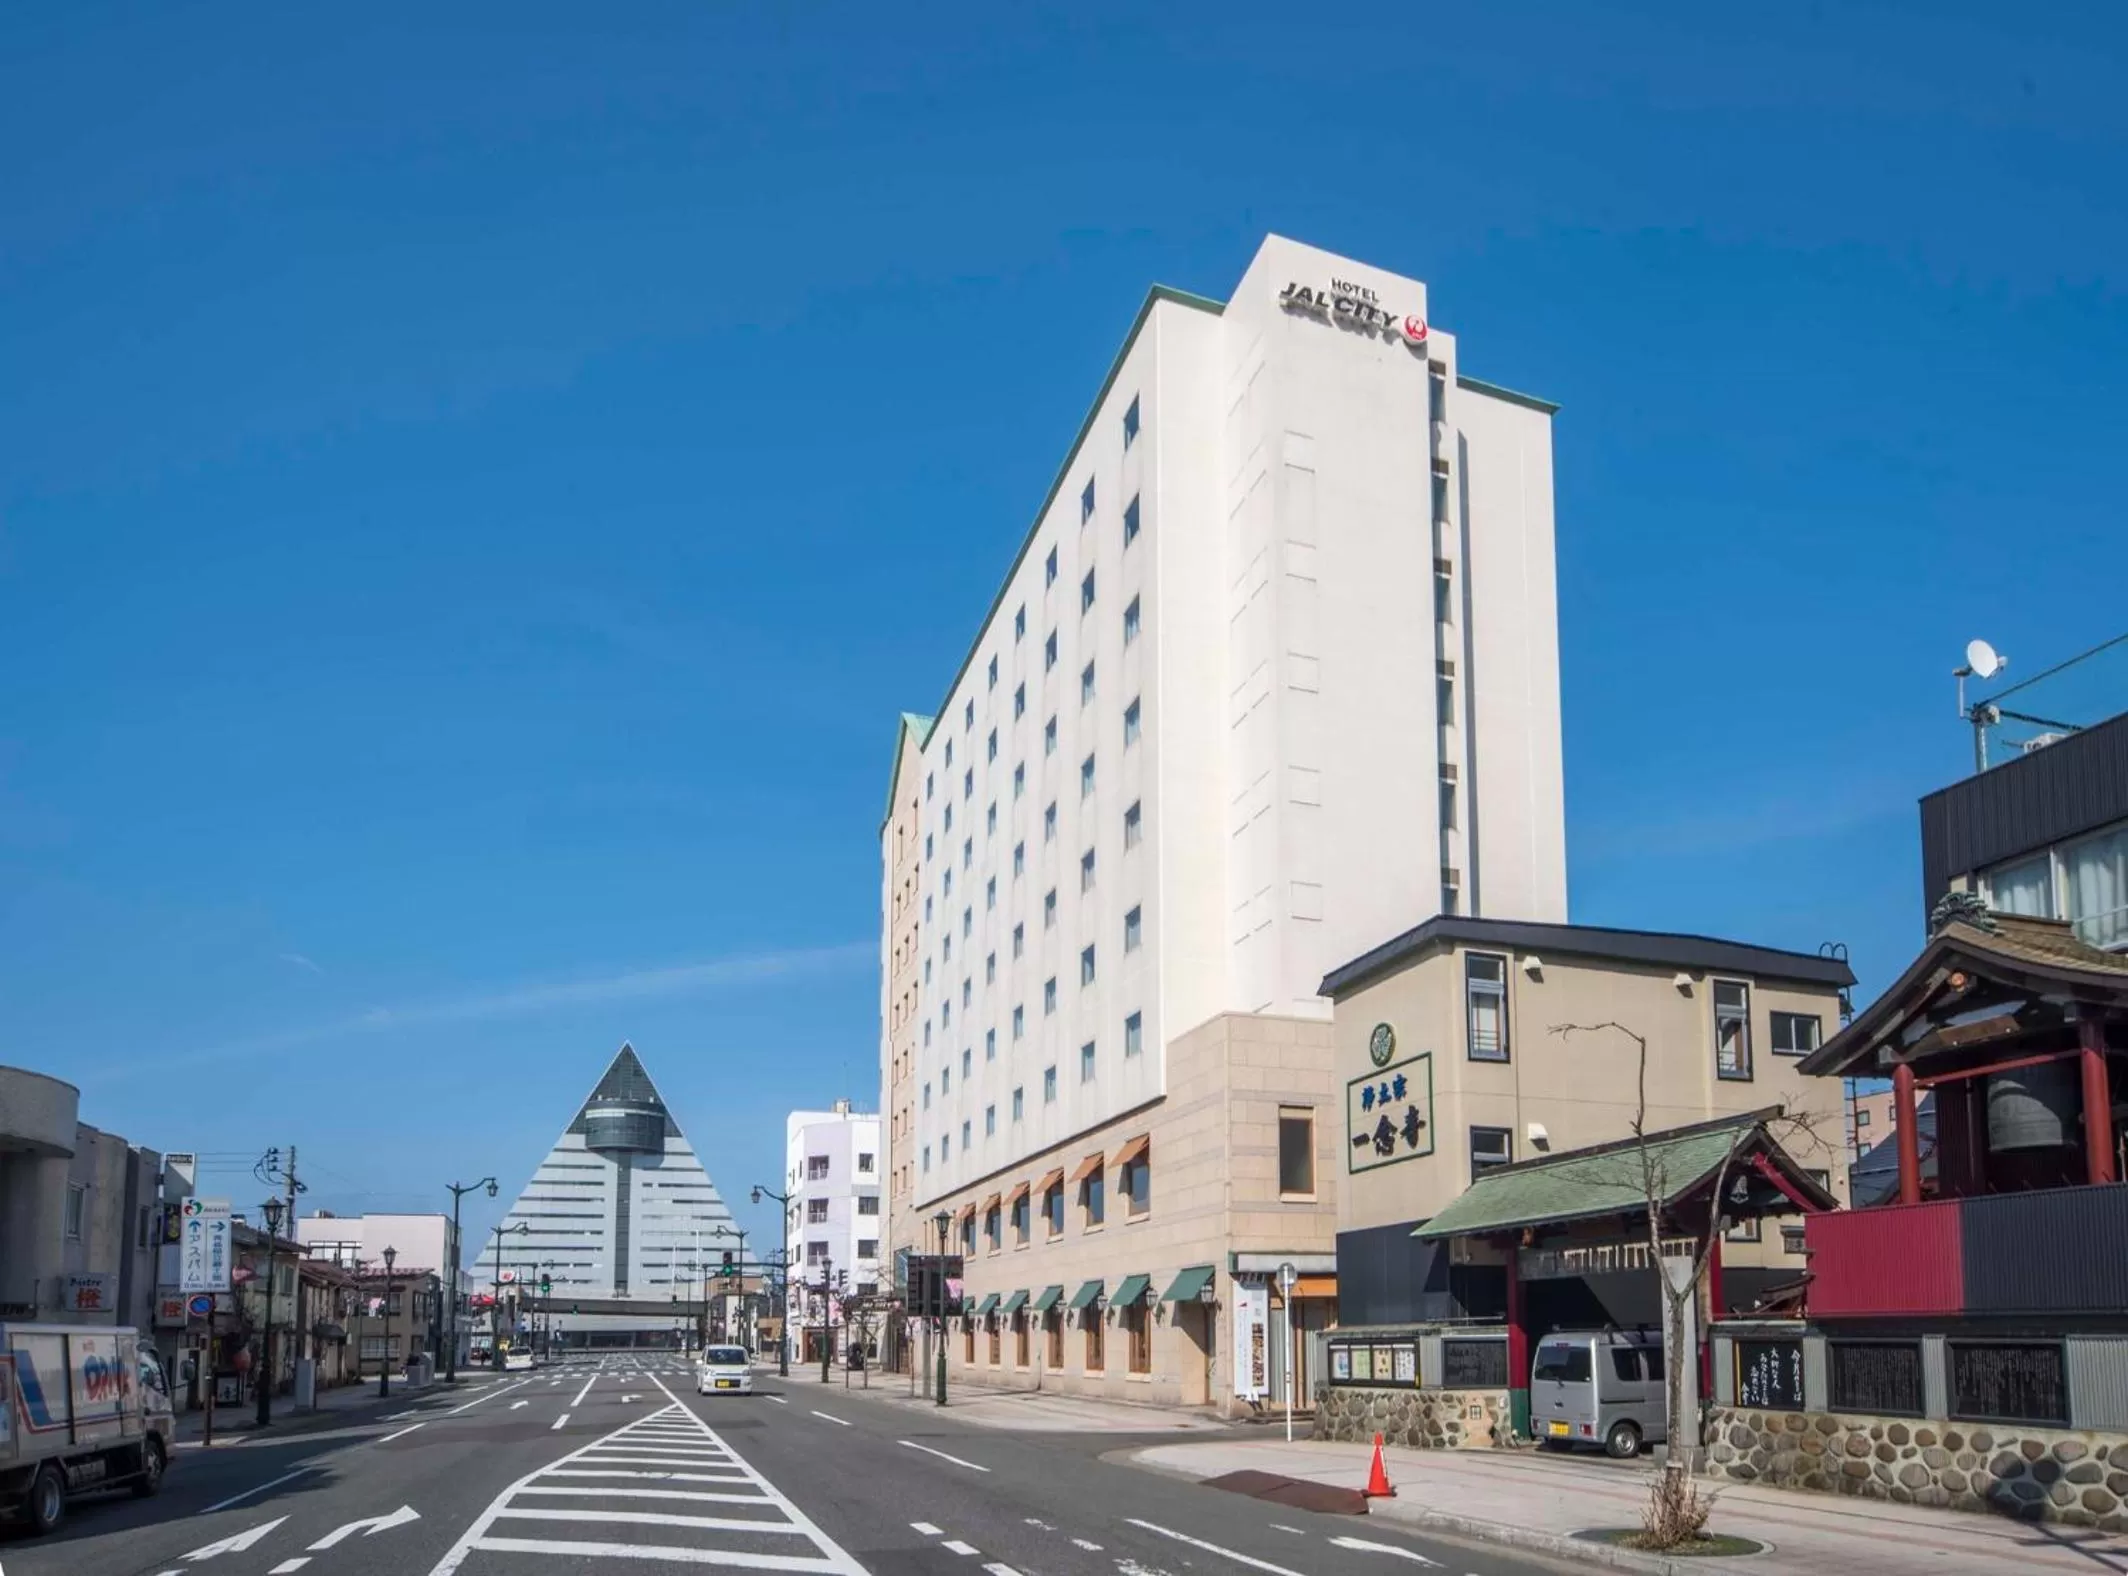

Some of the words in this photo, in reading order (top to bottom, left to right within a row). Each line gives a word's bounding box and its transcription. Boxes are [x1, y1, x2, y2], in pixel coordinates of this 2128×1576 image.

[1280, 282, 1330, 308] JAL
[1333, 296, 1399, 327] CITY
[1331, 277, 1380, 301] HOTEL
[1352, 1104, 1427, 1156] 一念寺
